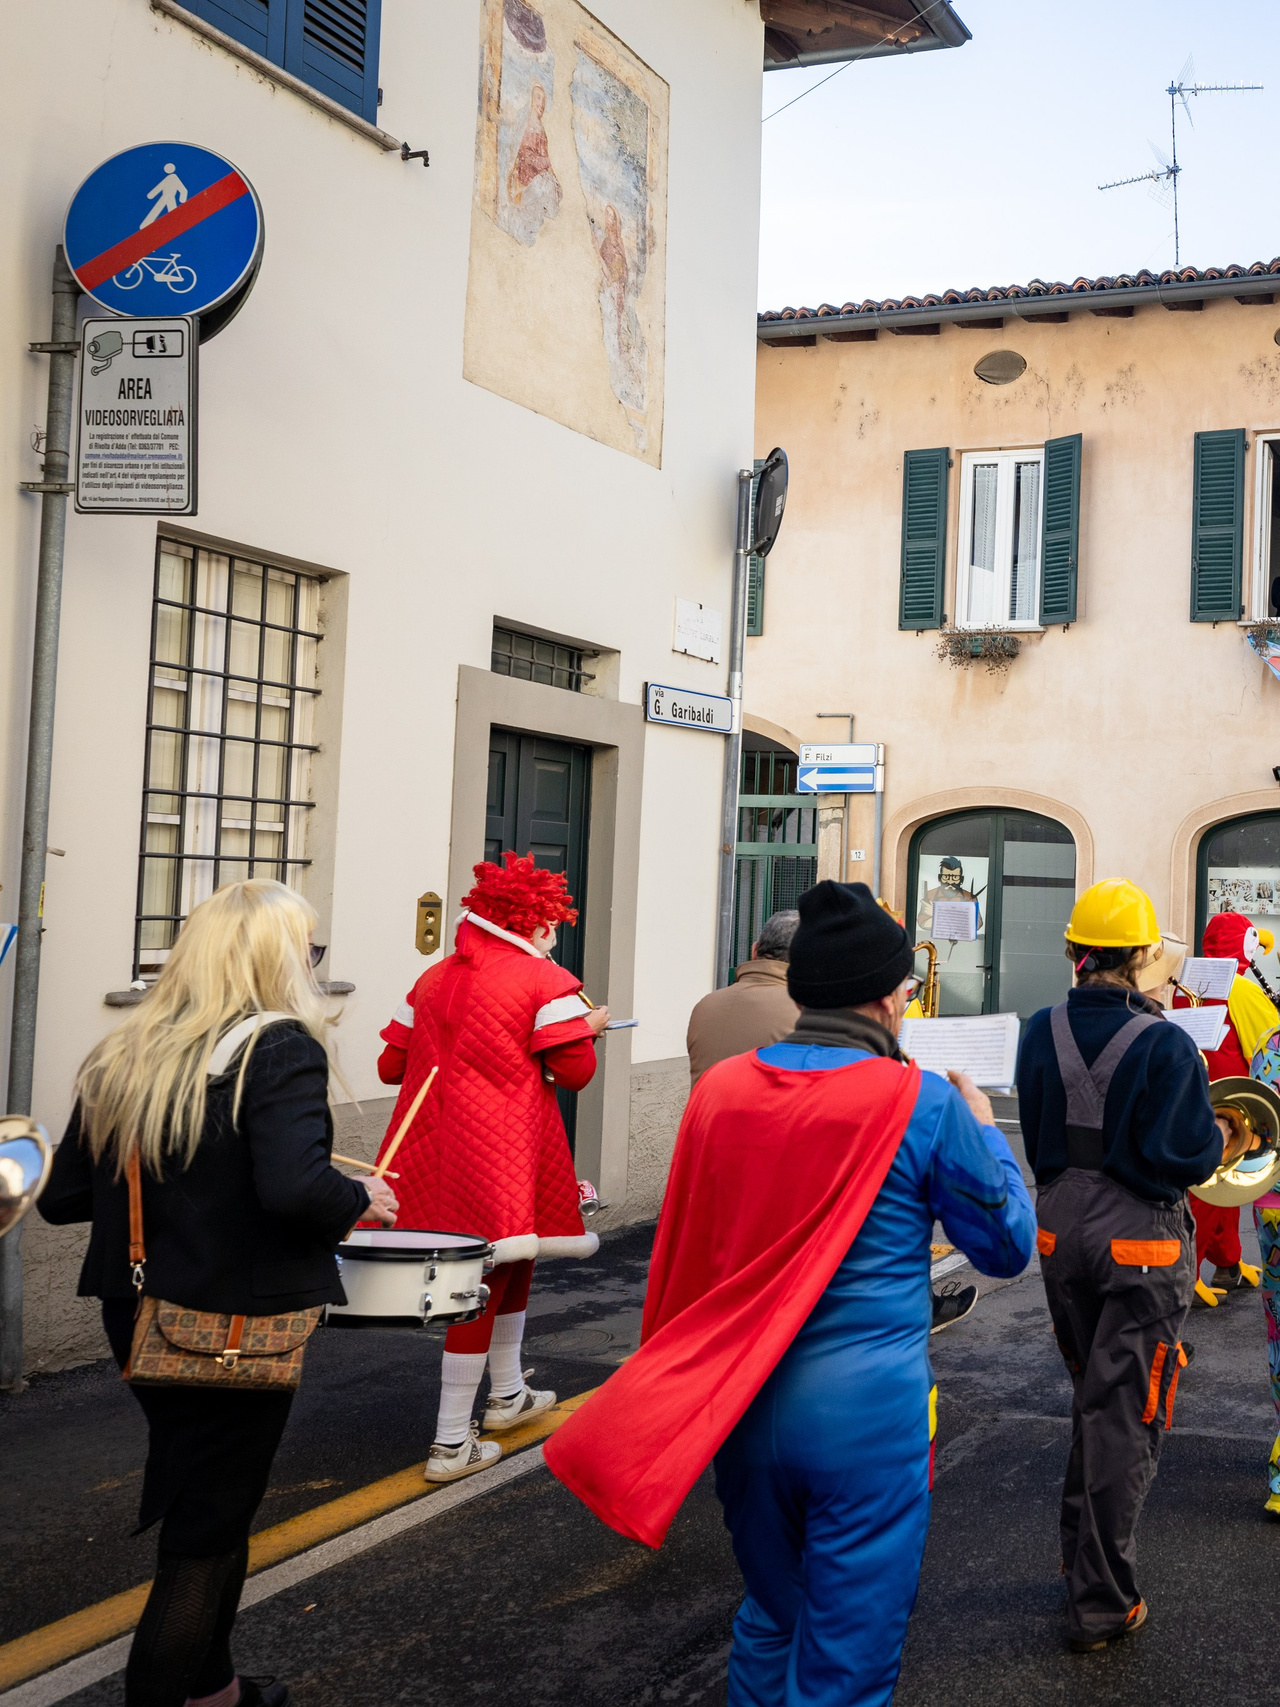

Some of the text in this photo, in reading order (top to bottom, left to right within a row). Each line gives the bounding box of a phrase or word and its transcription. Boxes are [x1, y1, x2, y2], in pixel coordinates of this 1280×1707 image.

[118, 378, 152, 399] AREA
[85, 409, 185, 426] VIDEOSORVEGLIATA
[96, 433, 125, 441] registrazione
[148, 473, 176, 481] regolamento
[102, 481, 114, 490] degli
[114, 482, 134, 490] impianti
[655, 688, 664, 698] via
[654, 699, 714, 724] G. Garibaldi
[805, 753, 833, 761] F. Filzi
[855, 851, 862, 859] 12
